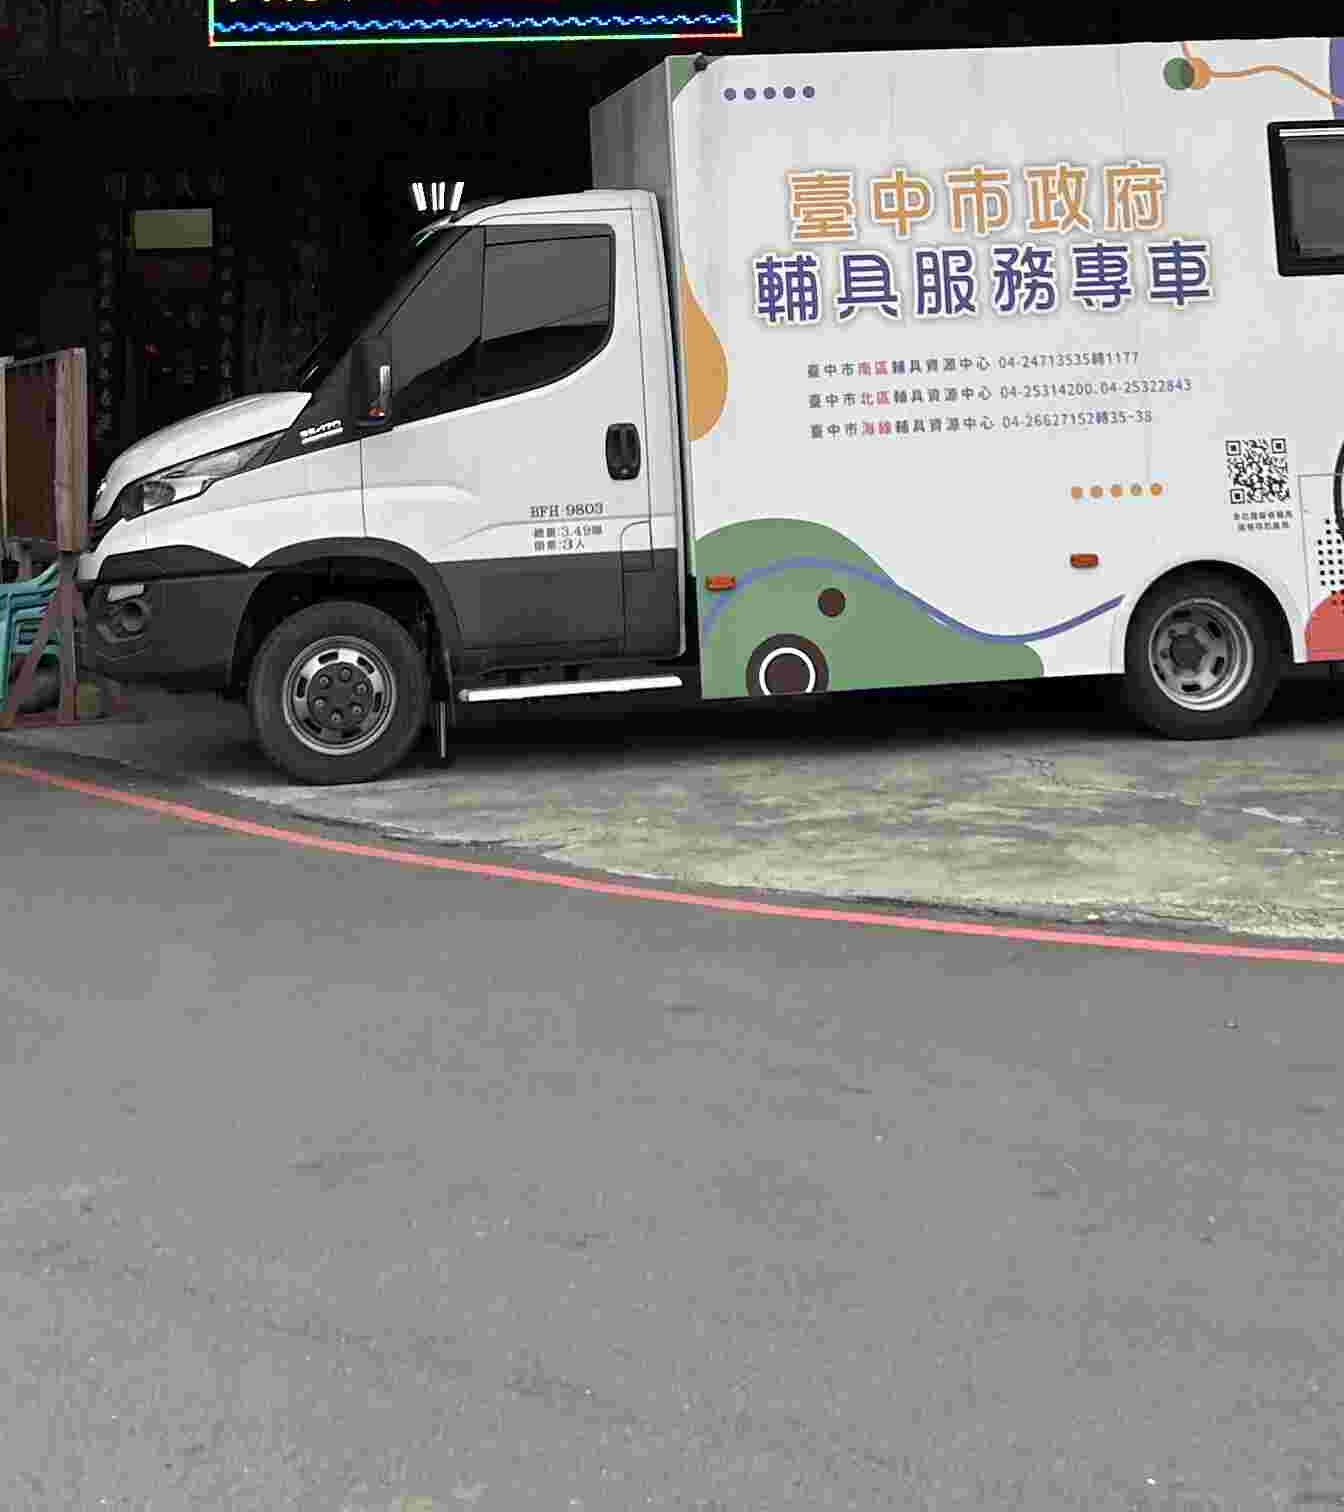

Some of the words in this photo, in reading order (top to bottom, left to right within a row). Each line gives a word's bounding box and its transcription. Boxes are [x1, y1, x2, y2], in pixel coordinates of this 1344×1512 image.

[786, 162, 1170, 241] 臺中市政府
[754, 240, 1212, 324] 輔具服務專車
